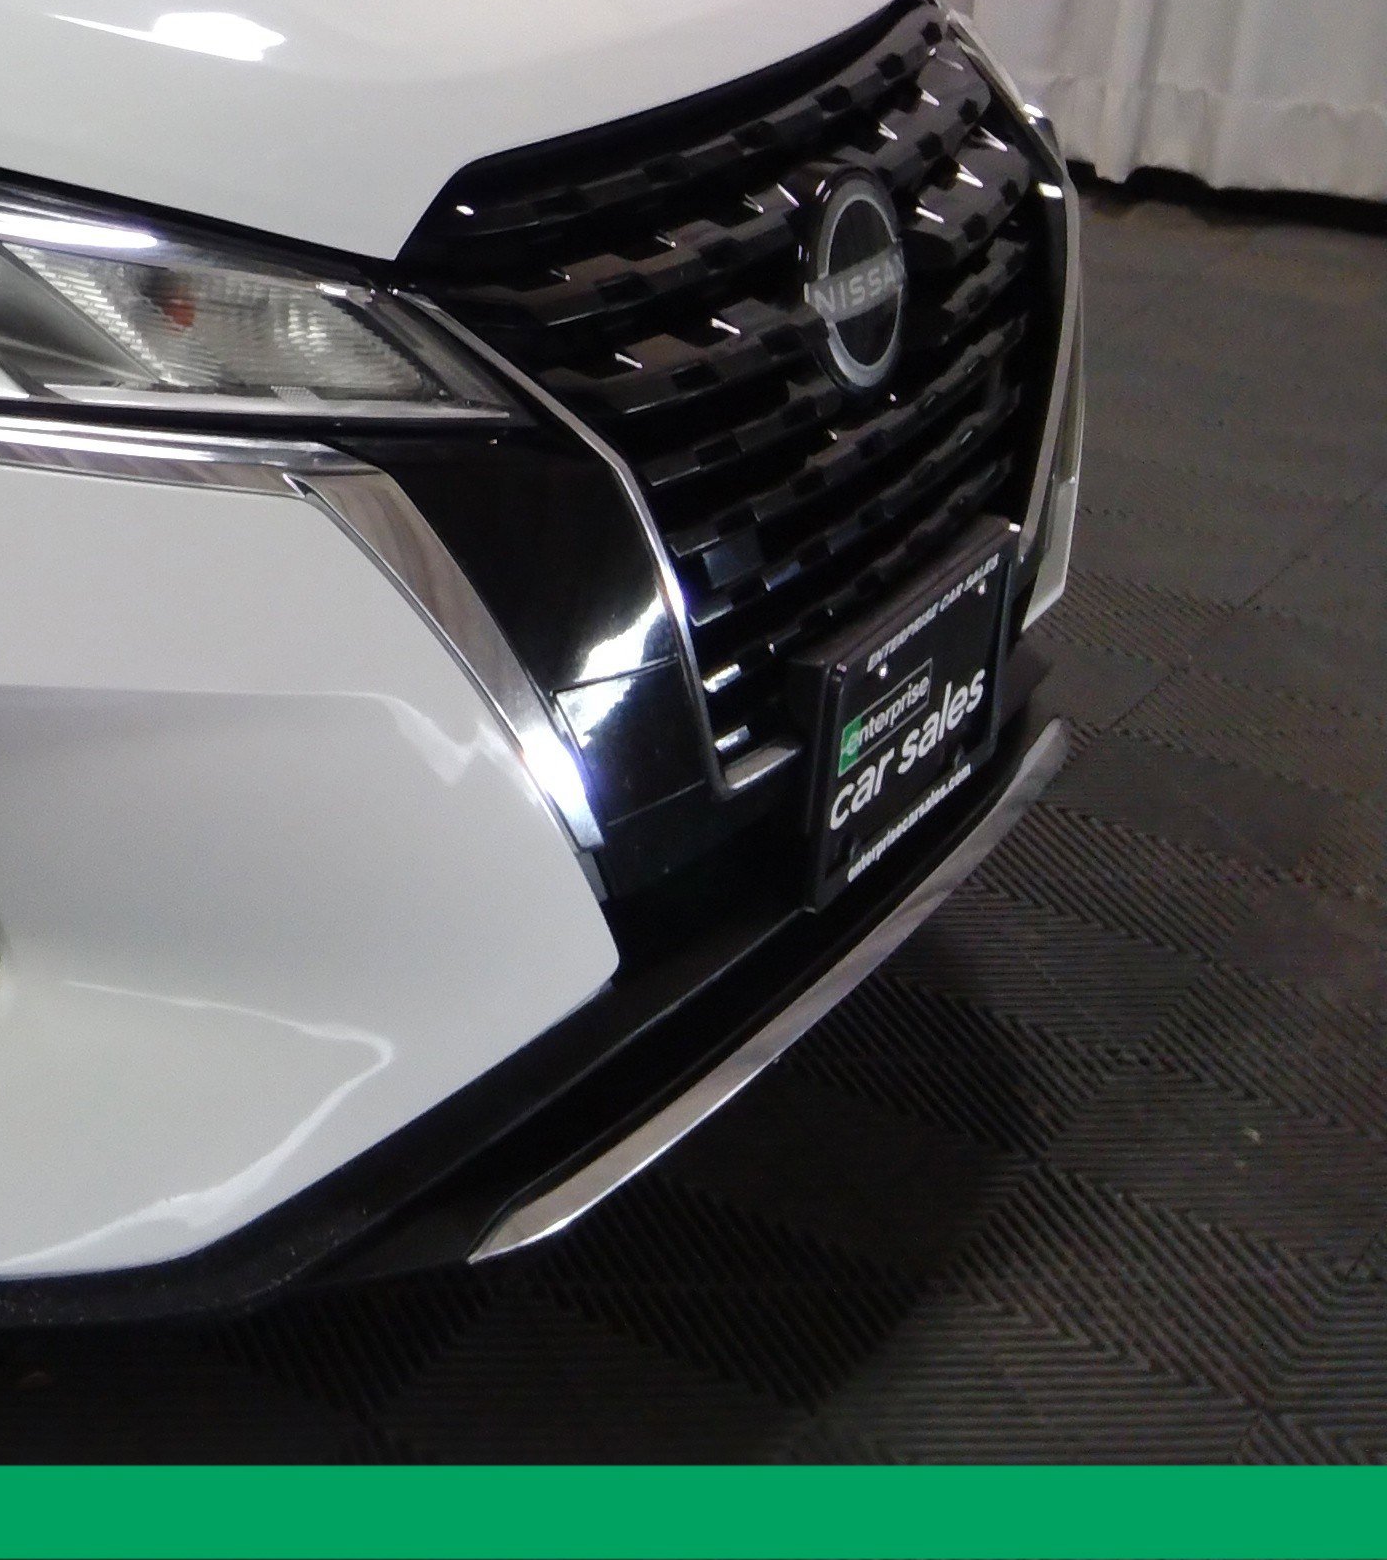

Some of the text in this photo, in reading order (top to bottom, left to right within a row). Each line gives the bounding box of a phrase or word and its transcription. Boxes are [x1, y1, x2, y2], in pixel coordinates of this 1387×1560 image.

[829, 668, 986, 830] car sales
[842, 676, 930, 756] enterprise
